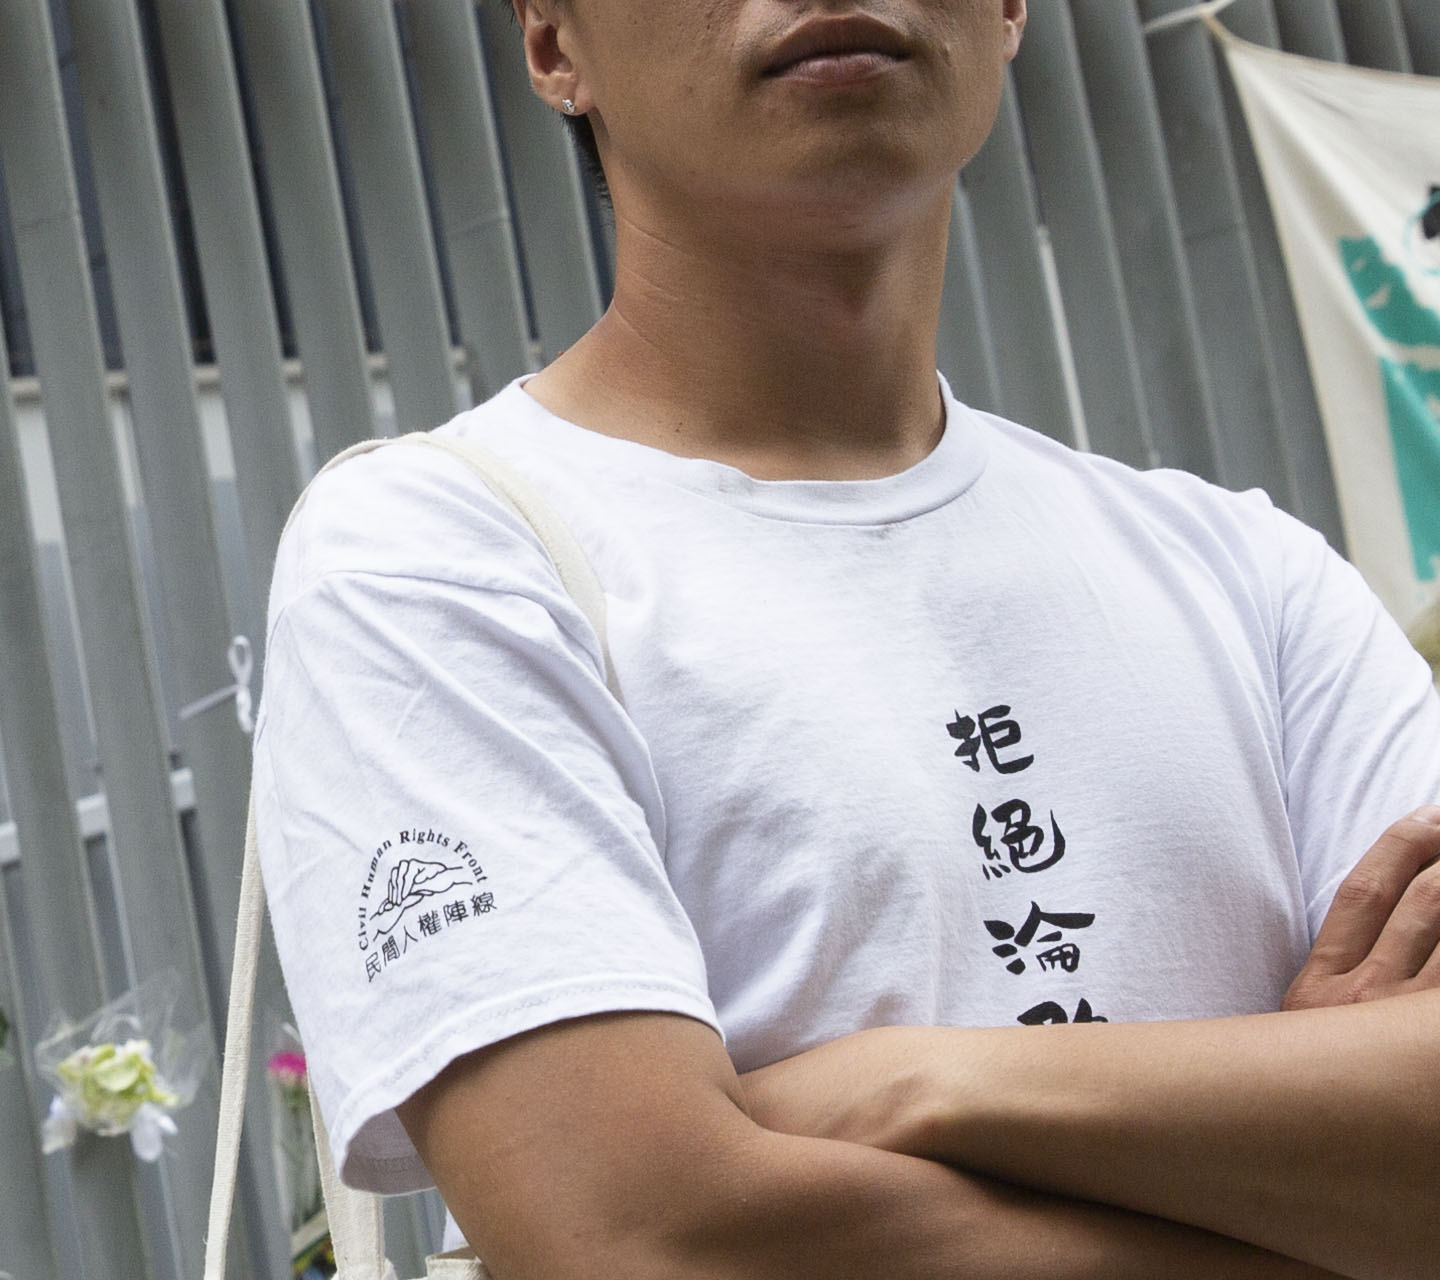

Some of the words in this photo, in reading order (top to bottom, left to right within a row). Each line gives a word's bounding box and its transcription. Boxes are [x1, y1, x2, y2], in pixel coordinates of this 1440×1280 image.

[399, 828, 451, 848] Rights
[361, 839, 392, 898] Human
[453, 841, 488, 884] Front
[358, 906, 369, 951] Civil
[365, 892, 498, 983] 民間人權陣線
